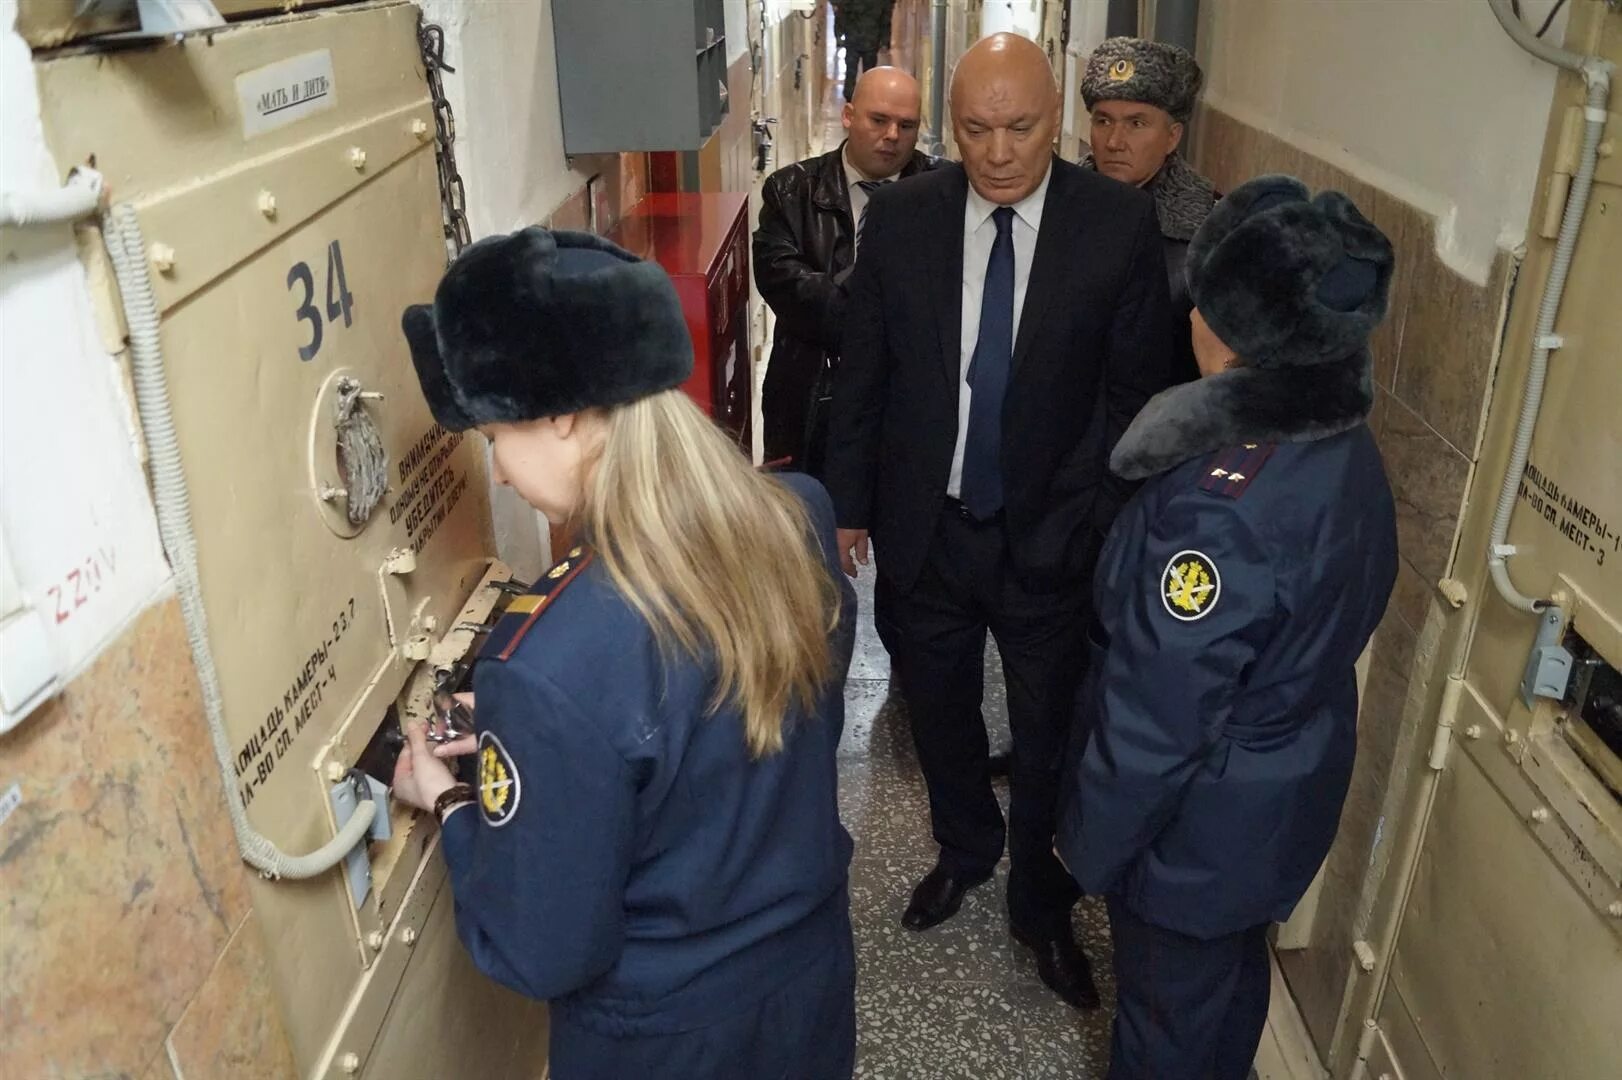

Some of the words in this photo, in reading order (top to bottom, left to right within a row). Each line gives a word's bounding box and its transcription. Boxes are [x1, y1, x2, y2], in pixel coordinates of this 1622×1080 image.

[256, 87, 289, 113] «МАТЬ
[292, 83, 299, 101] И
[286, 239, 354, 362] 34
[405, 464, 454, 537] УБЕДИТЕСЬ
